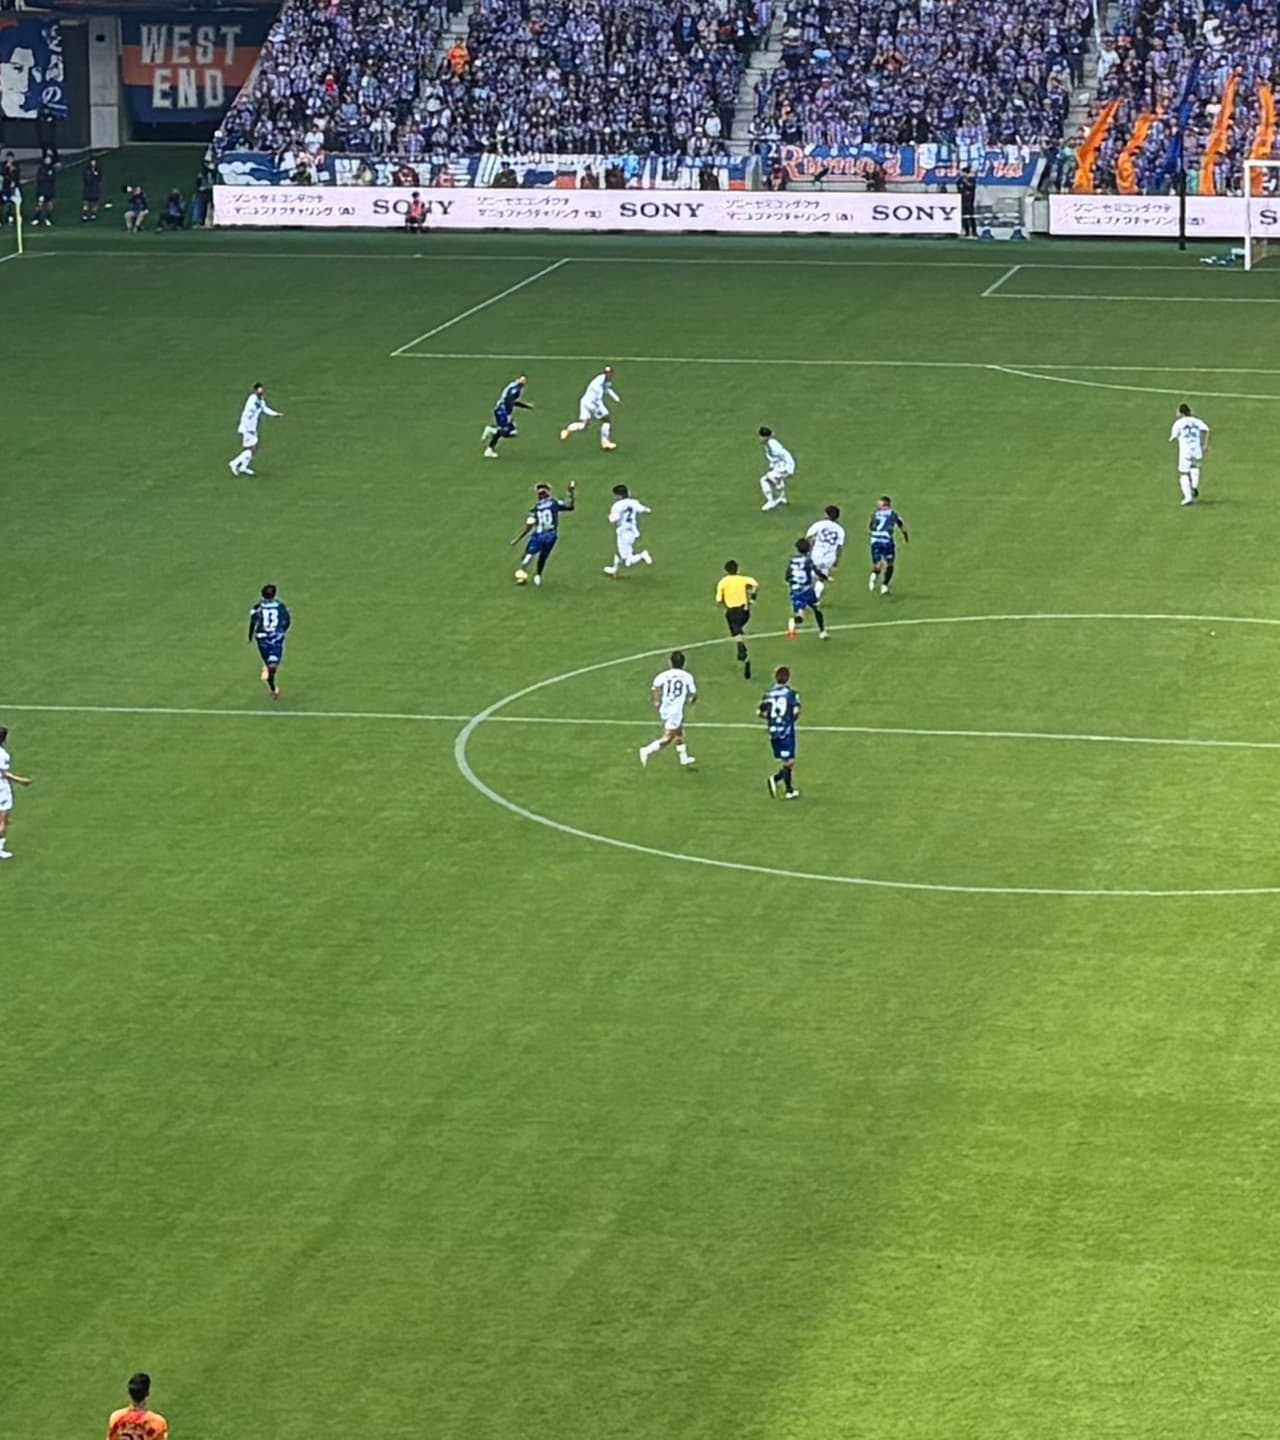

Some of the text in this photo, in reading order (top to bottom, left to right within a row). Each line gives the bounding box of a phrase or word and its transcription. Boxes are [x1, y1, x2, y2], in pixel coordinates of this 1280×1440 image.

[141, 25, 242, 66] WEST
[153, 70, 225, 108] END
[620, 202, 705, 218] SONY
[871, 205, 958, 221] SONY
[625, 507, 634, 522] 2
[875, 516, 887, 531] 7
[667, 679, 683, 698] 18
